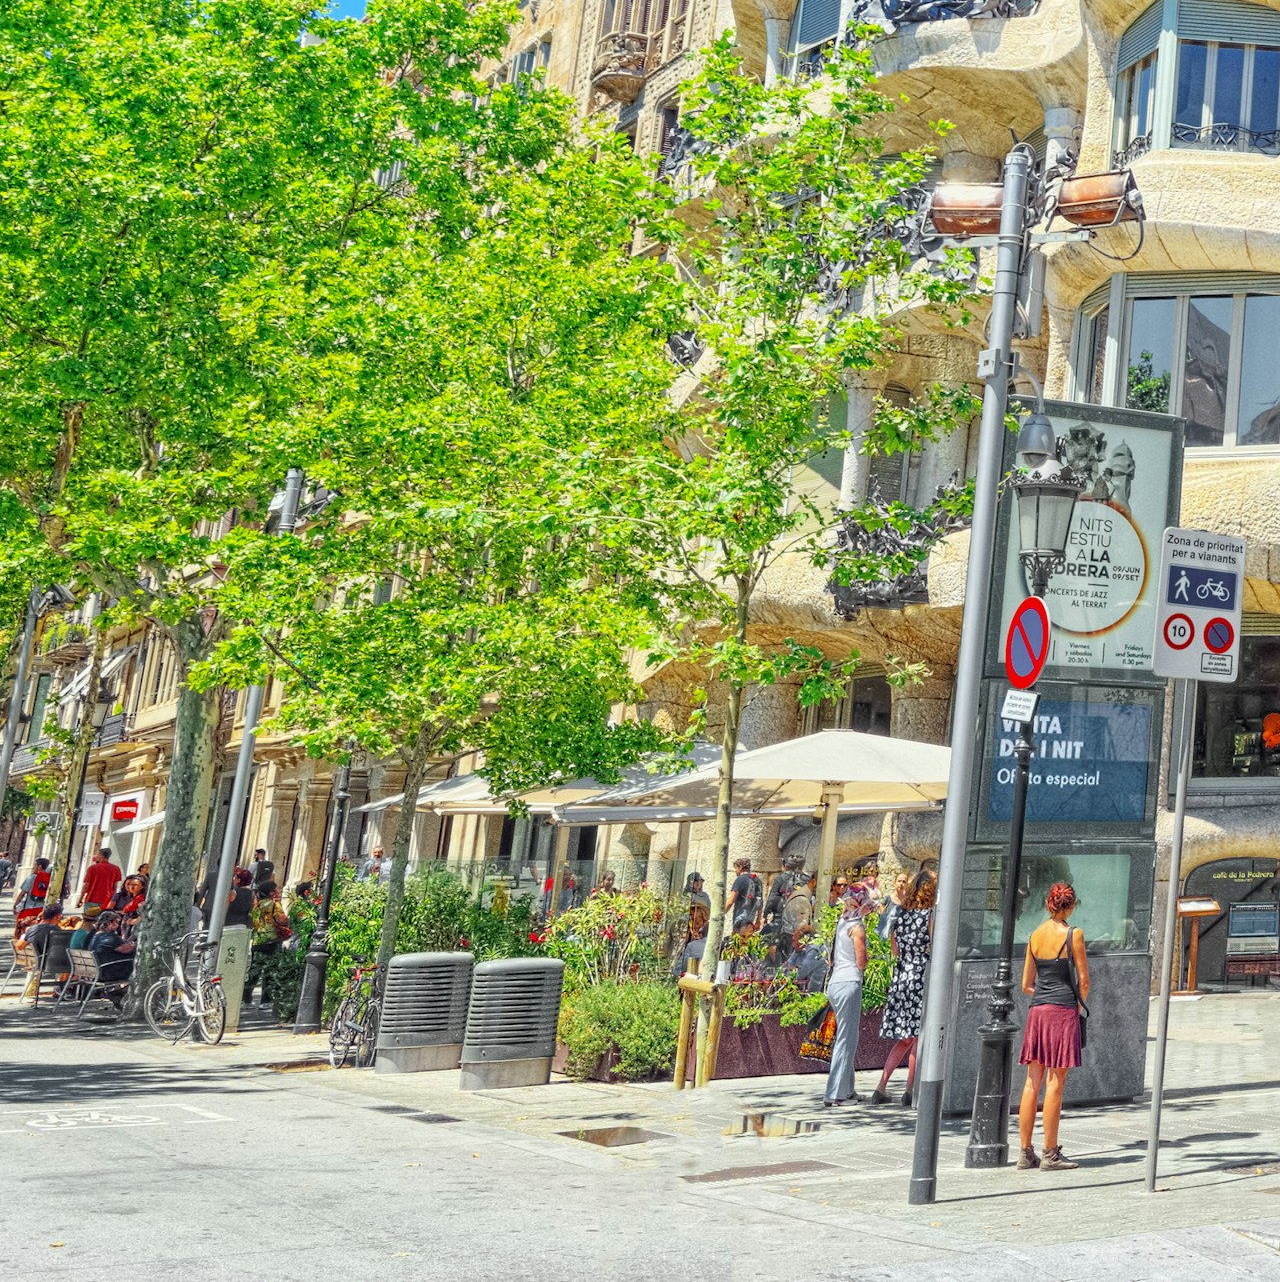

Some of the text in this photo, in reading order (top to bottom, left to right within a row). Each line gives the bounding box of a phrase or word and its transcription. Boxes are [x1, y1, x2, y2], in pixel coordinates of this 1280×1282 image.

[1079, 517, 1113, 533] NITS
[1167, 534, 1244, 554] Zona de prioritat
[1075, 549, 1111, 563] A LA
[1172, 549, 1237, 565] per a vianants
[1112, 565, 1140, 574] 09/JUN
[1112, 573, 1140, 582] 09/SET
[1045, 587, 1108, 599] ONCERTS DE JAZZ
[1172, 626, 1187, 637] 10
[1002, 715, 1062, 734] VIITA
[1052, 740, 1084, 759] NIT
[1045, 771, 1100, 788] especial
